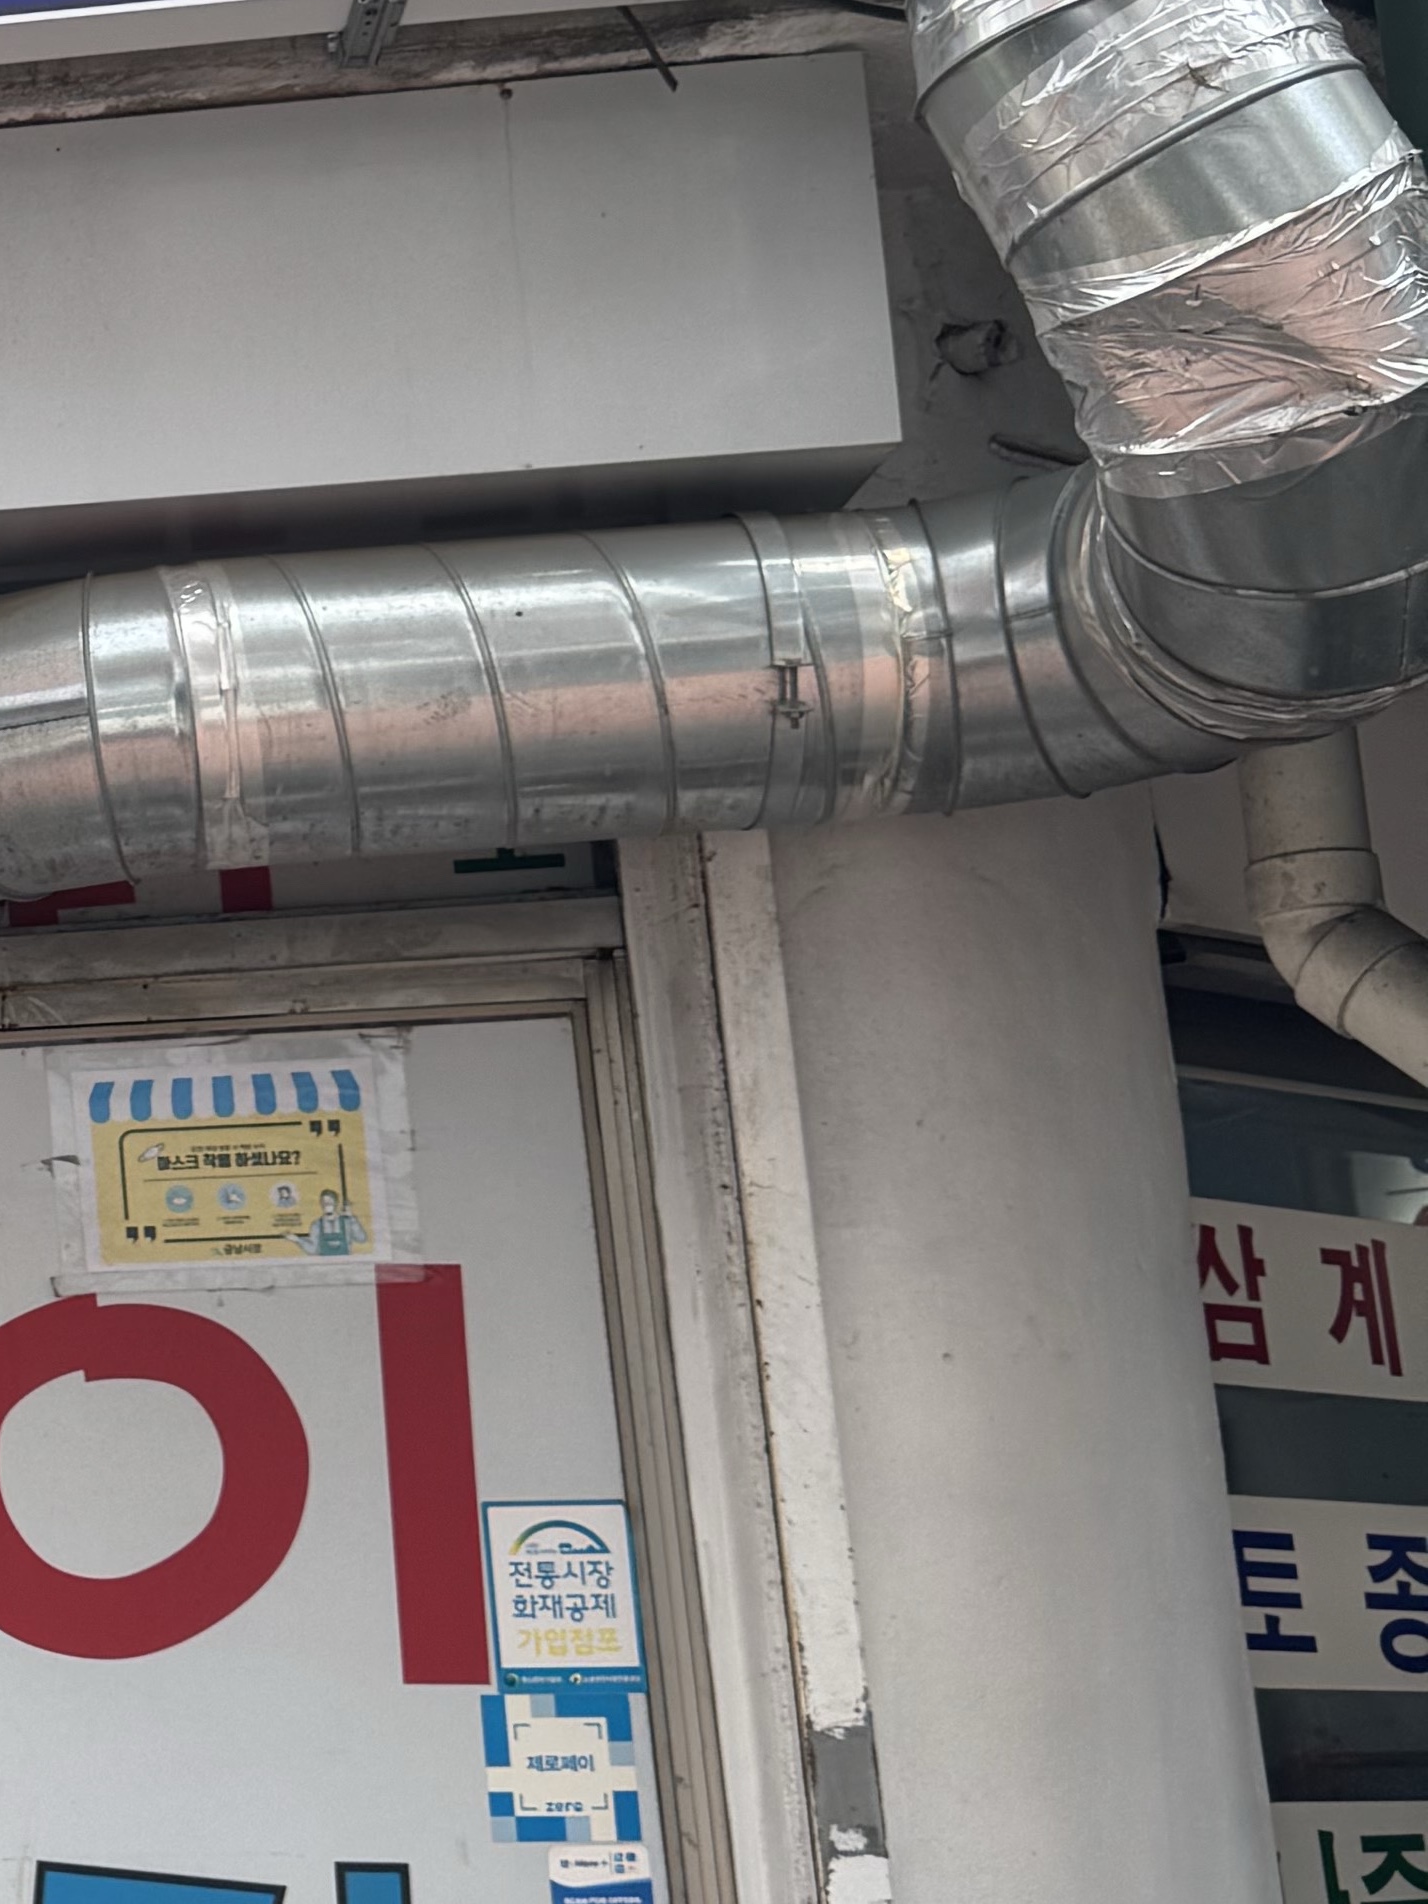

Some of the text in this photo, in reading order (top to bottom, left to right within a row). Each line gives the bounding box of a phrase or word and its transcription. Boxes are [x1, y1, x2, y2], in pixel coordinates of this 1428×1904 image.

[508, 1560, 614, 1589] 전통시장
[512, 1593, 618, 1622] 화재공제
[518, 1627, 622, 1658] 가입점포
[526, 1754, 595, 1772] 제로페이
[545, 1801, 584, 1812] zero
